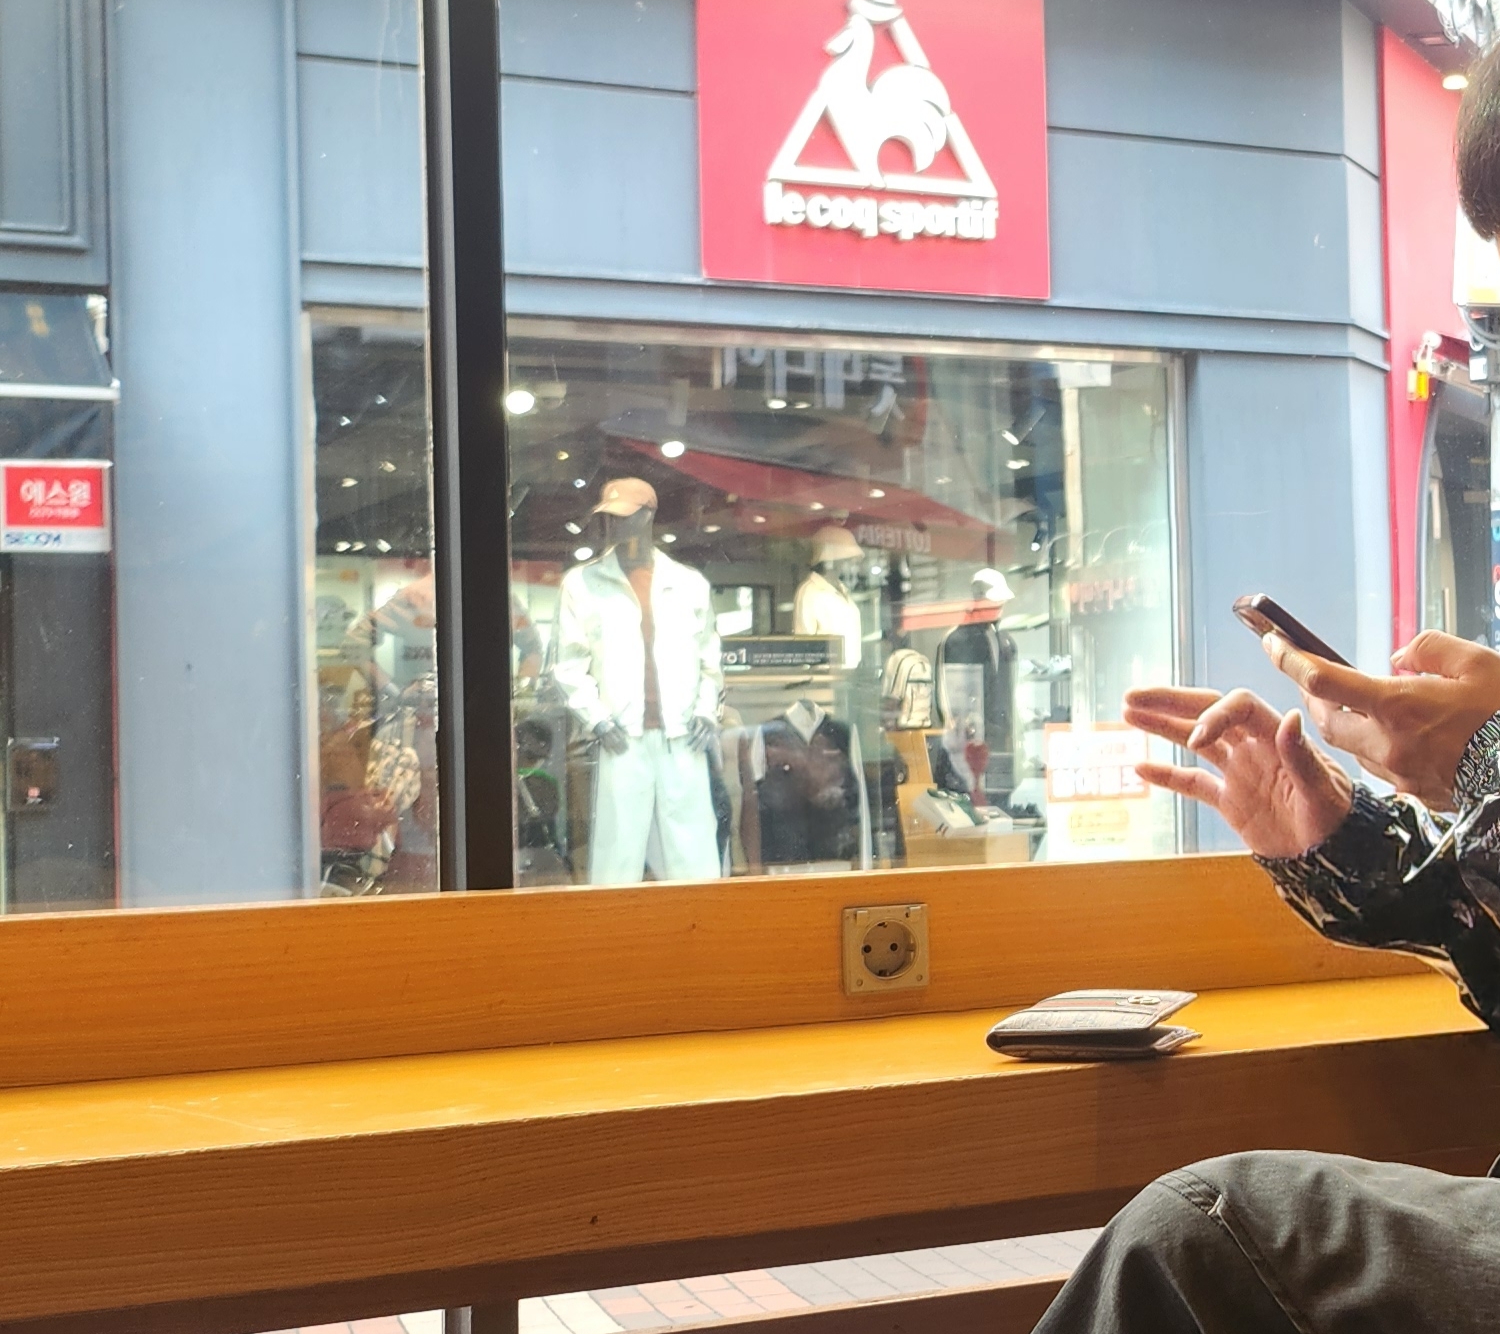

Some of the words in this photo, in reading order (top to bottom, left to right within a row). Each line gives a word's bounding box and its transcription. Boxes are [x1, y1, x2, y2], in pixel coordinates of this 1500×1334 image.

[764, 180, 805, 225] le
[806, 194, 878, 237] coq
[879, 196, 999, 241] sportif
[19, 478, 92, 508] 에스원
